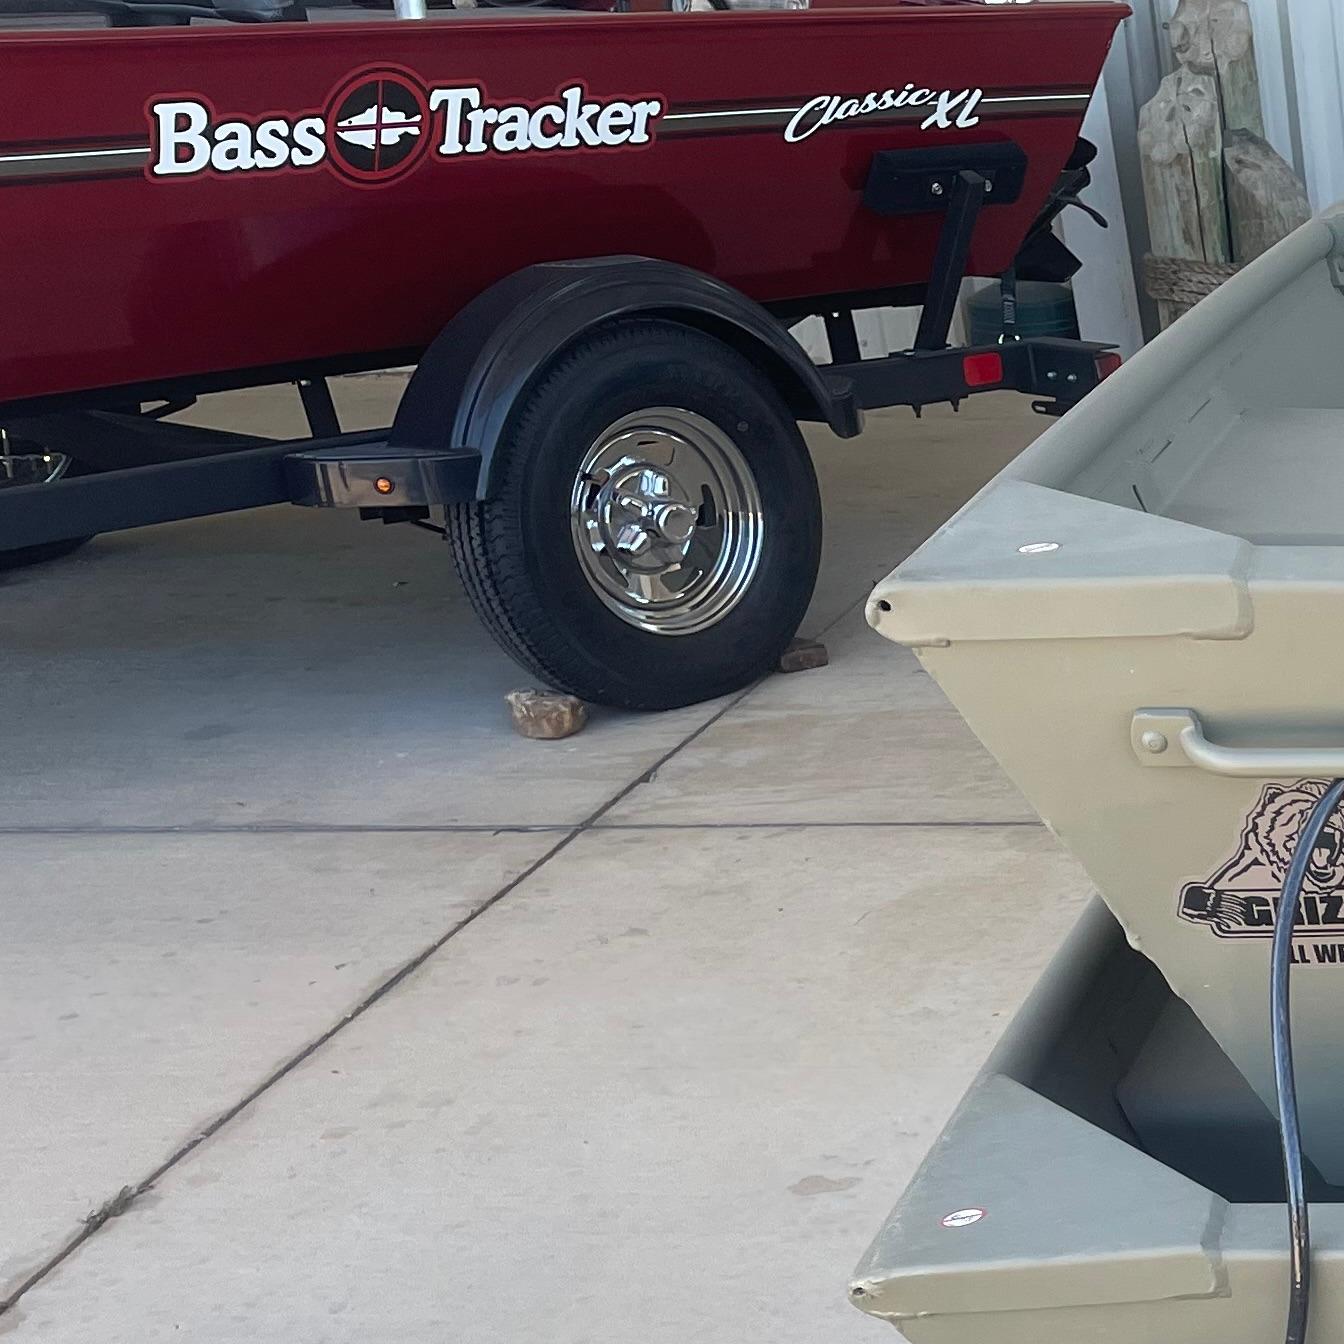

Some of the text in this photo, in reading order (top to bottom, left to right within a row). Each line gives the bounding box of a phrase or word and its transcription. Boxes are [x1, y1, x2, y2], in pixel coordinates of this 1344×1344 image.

[152, 87, 660, 175] Bass Tracker
[784, 84, 982, 142] Classic XL
